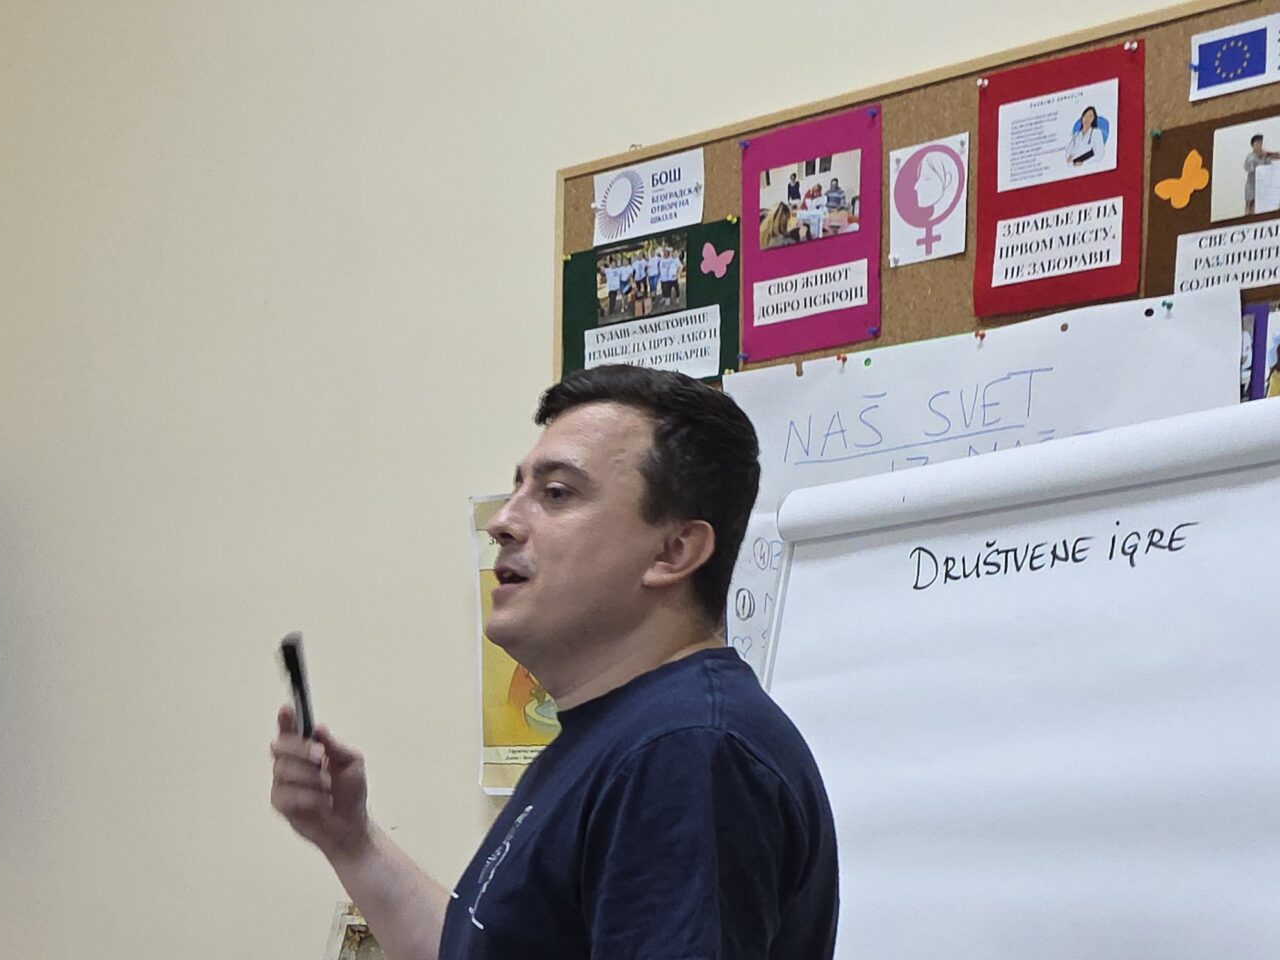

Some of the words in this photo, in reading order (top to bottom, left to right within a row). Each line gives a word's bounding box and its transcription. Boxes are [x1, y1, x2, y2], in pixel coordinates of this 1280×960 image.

[651, 167, 681, 188] БОШ
[650, 198, 689, 214] ОТВОРЕНА
[650, 212, 678, 224] ШКОЛА
[1002, 211, 1074, 238] ЗДРАВЉЕ
[1077, 206, 1093, 225] ЈЕ
[1096, 202, 1118, 219] НА
[999, 236, 1053, 260] ПРВОМ
[1198, 232, 1227, 249] СВЕ
[1230, 227, 1251, 244] СУ
[1004, 265, 1024, 280] НЕ
[1027, 249, 1111, 276] ЗАБОРАВИ
[768, 278, 798, 297] СВОЈ
[801, 267, 852, 289] ЖИВОТ
[757, 299, 800, 320] ДОБРО
[803, 285, 864, 309] ИСКРОЈИ
[596, 328, 630, 344] ГУЛАШ
[632, 342, 647, 354] НА
[784, 391, 887, 463] NAŠ
[924, 367, 1053, 437] SVET
[909, 538, 1096, 590] DRUŠTVENE
